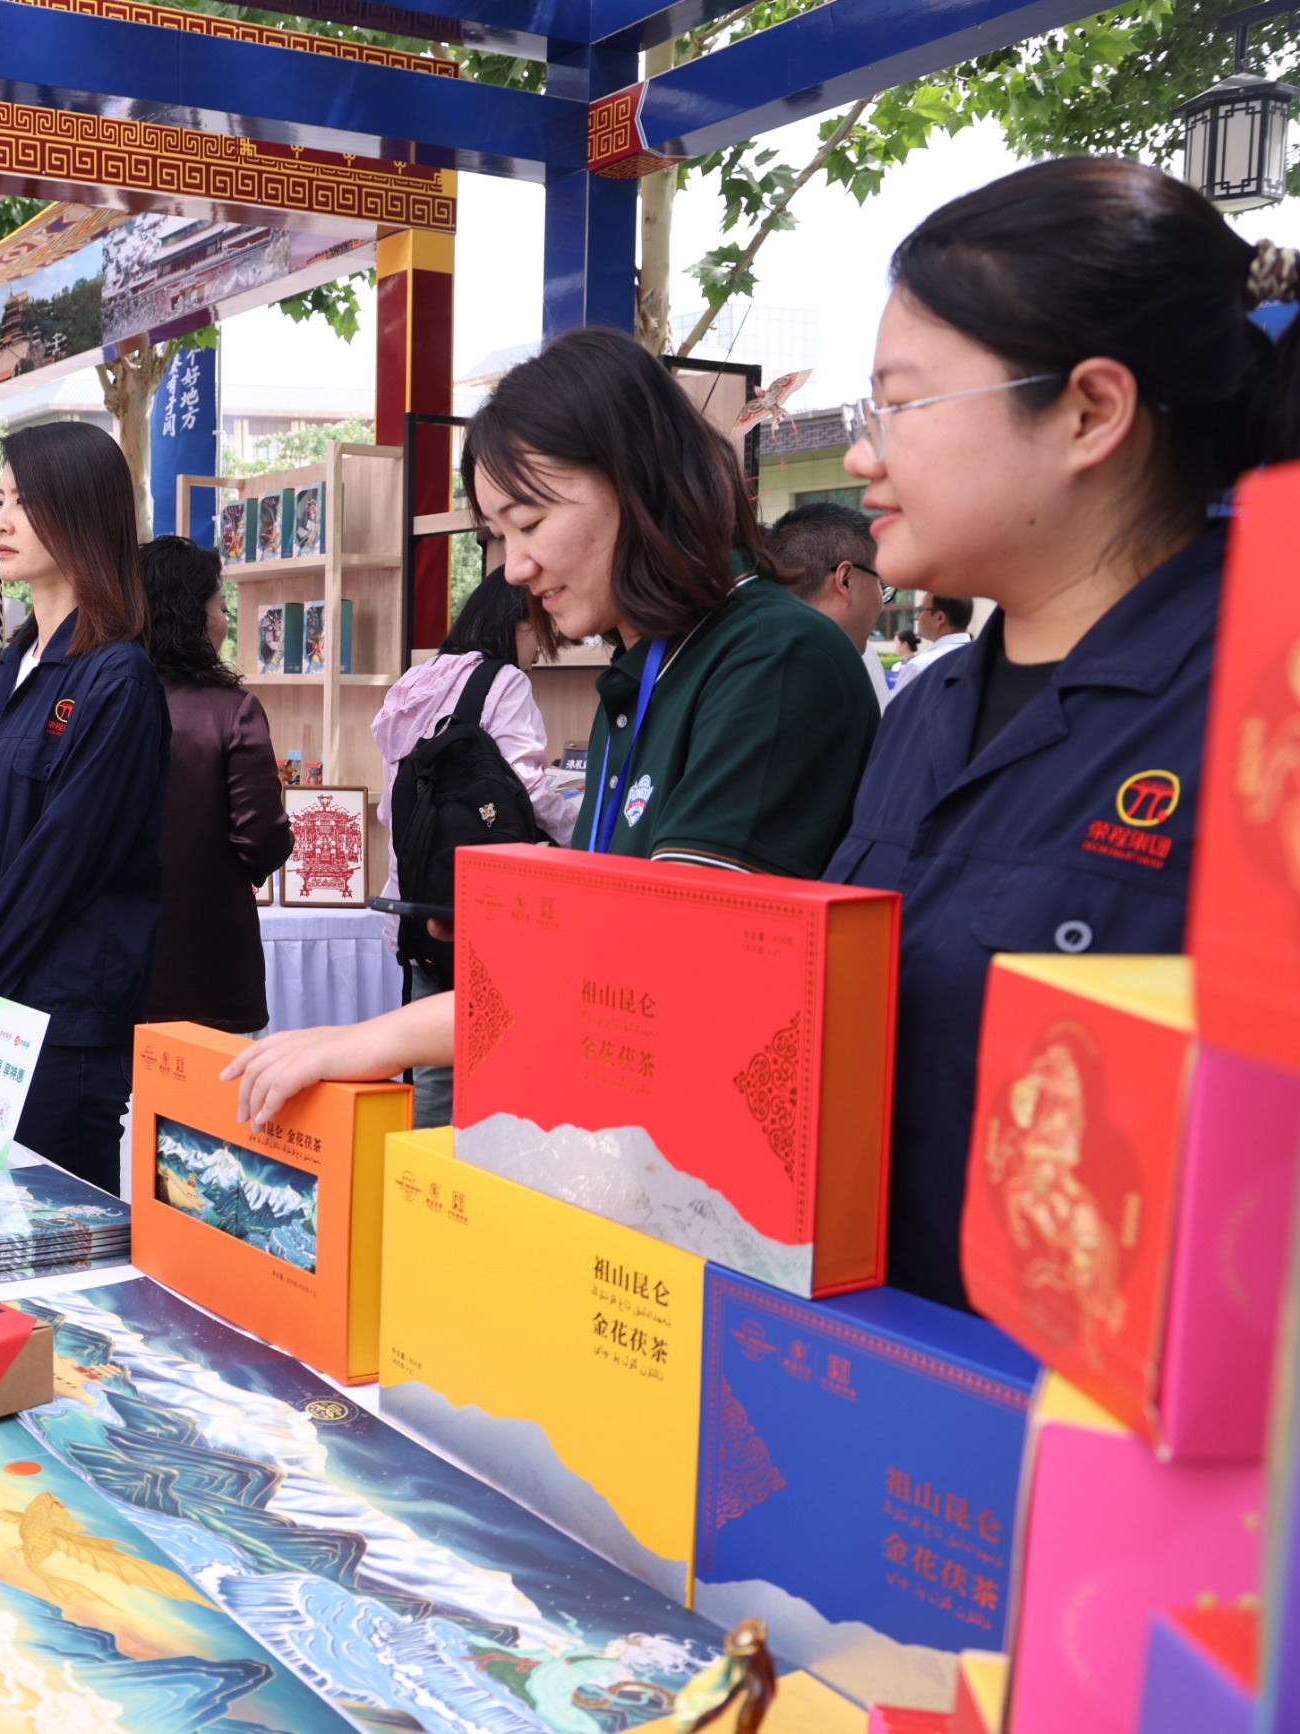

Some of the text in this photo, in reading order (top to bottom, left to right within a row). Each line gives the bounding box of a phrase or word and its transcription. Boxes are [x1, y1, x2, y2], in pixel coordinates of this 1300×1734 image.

[581, 979, 656, 1019] 祖山昆仑
[3, 1062, 25, 1083] 享特惠
[582, 1035, 655, 1077] 金花茯茶
[287, 1128, 322, 1153] 金花茯茶
[594, 1254, 670, 1307] 祖山昆仑
[592, 1312, 669, 1365] 金花茯茶
[887, 1464, 1003, 1545] 祖山昆仑
[884, 1533, 1000, 1612] 金花茯茶
